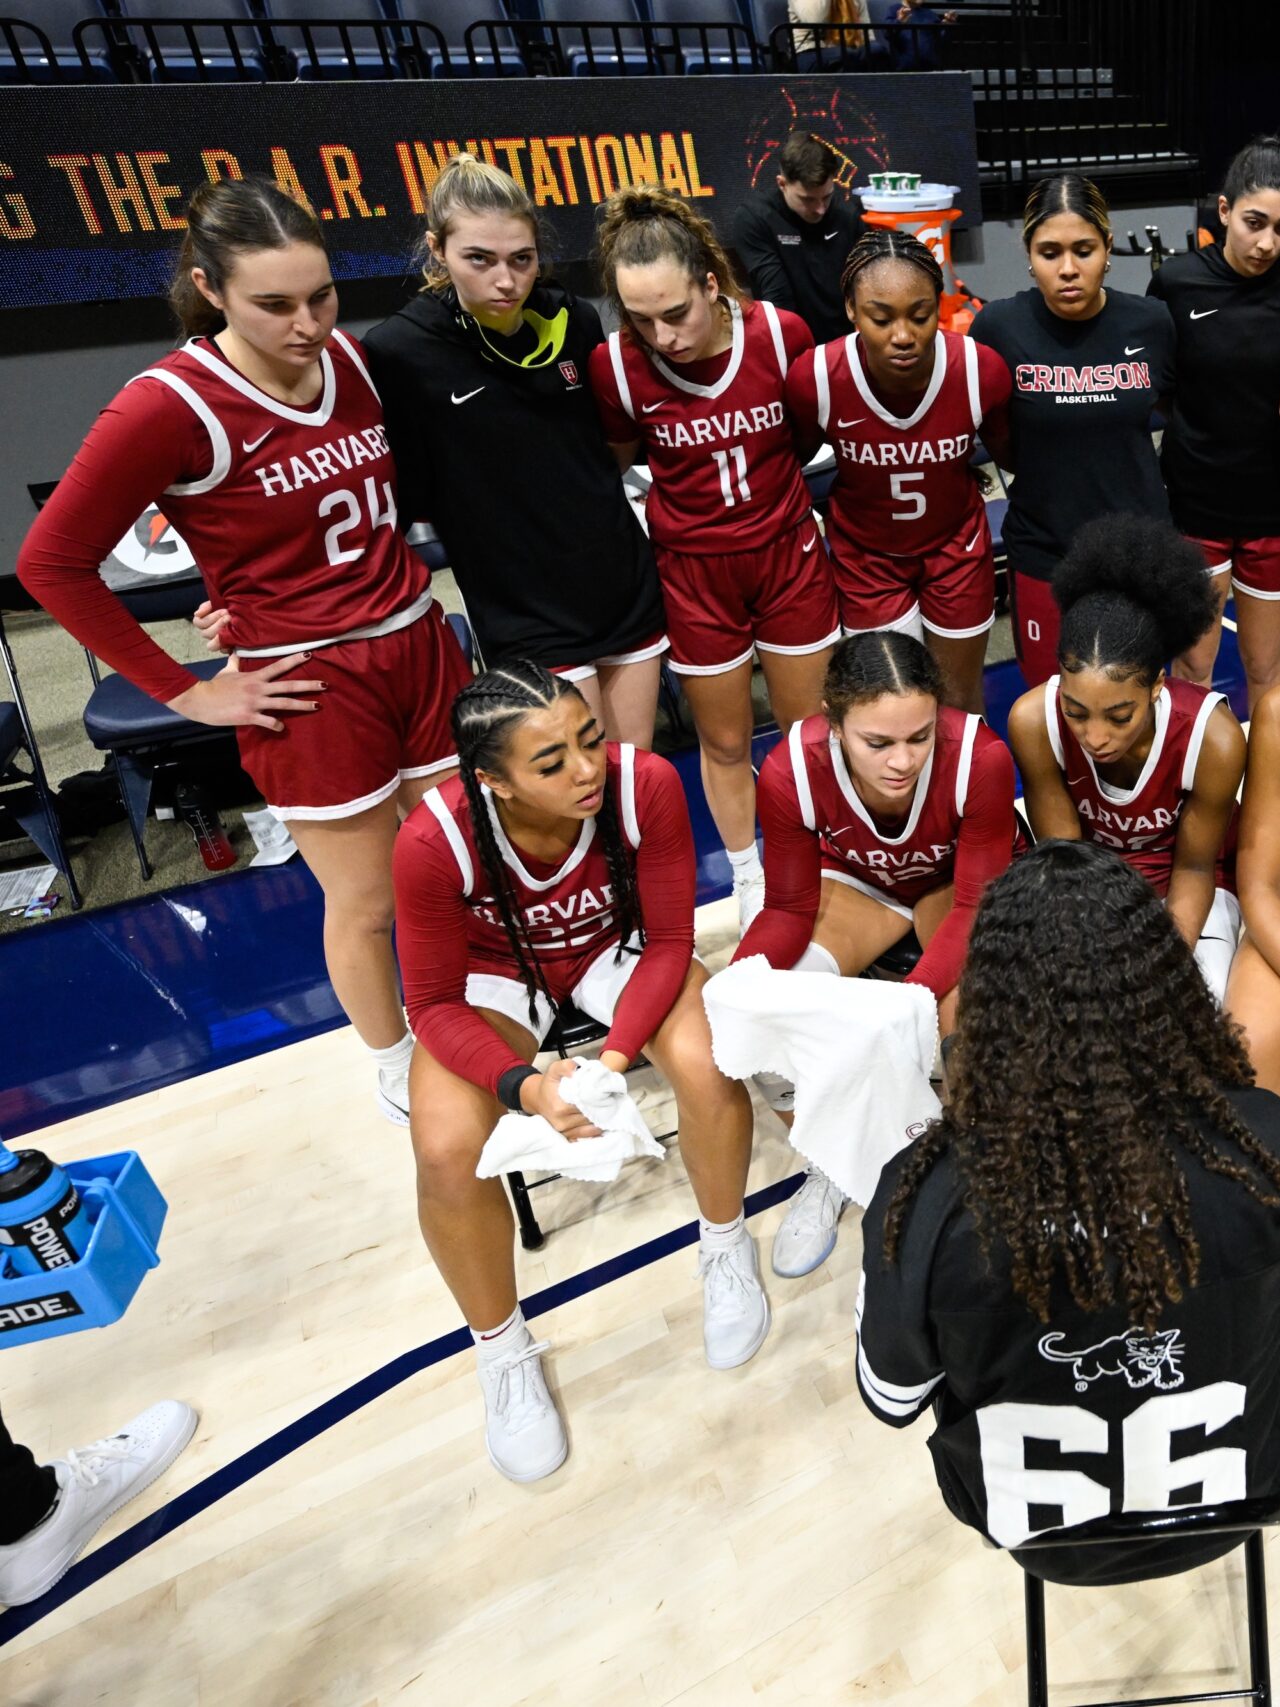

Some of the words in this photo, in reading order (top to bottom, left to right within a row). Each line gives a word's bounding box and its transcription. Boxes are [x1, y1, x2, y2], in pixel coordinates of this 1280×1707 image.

[47, 151, 188, 235] THE
[1015, 362, 1151, 393] CRIMSON
[1055, 393, 1117, 404] BASKETBALL
[652, 401, 784, 449] HARVARD
[839, 435, 970, 467] HARVARD
[711, 446, 752, 507] 11
[890, 473, 926, 521] 5
[318, 476, 398, 567] 24
[832, 839, 958, 869] ARVAR
[976, 1380, 1247, 1549] 66
